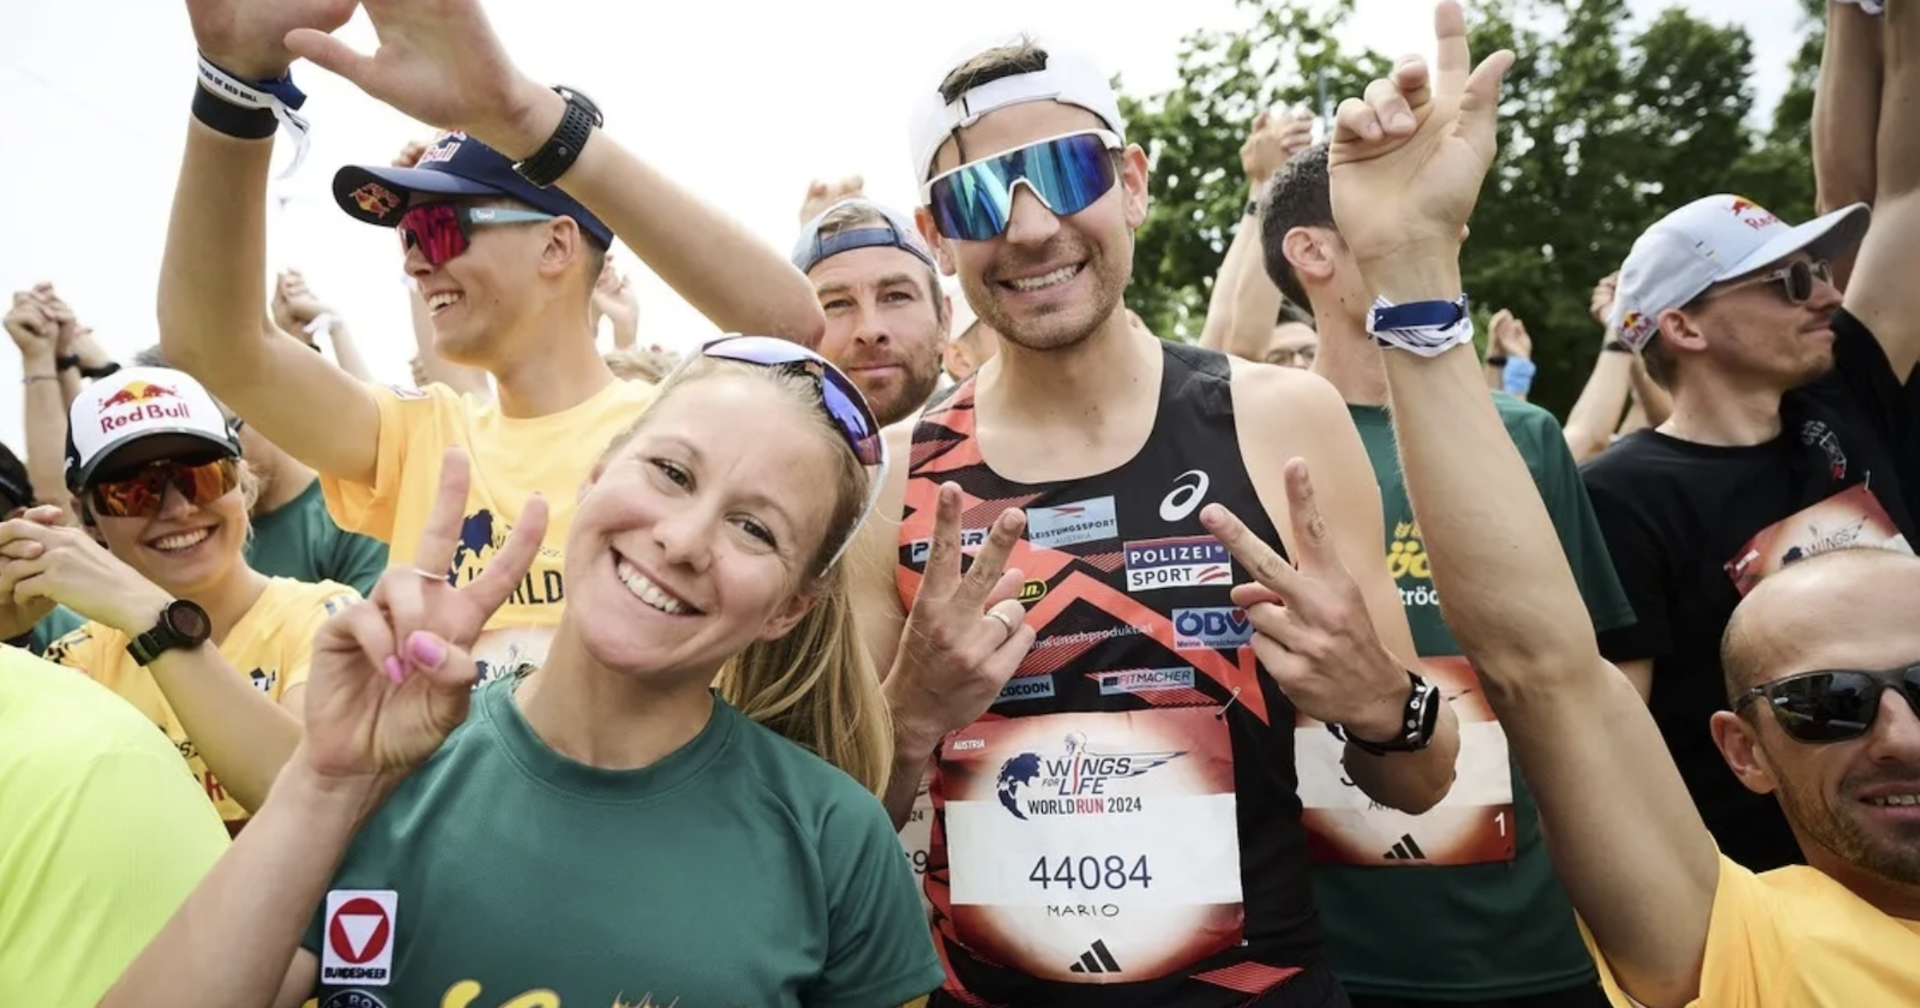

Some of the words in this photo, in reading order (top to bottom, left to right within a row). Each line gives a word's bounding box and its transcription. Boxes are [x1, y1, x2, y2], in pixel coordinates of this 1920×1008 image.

[100, 406, 144, 434] Red
[146, 402, 190, 419] Bull
[1030, 519, 1115, 540] LEISTUNGSSPORT
[1055, 533, 1092, 545] AUSTRIA
[1130, 545, 1211, 564] POLIZEI
[1132, 567, 1192, 587] SPORT
[1119, 670, 1191, 685] FITMACHER
[953, 738, 985, 750] AUSTRIA
[1046, 756, 1131, 776] WINGS
[1042, 778, 1060, 787] FOR
[1058, 777, 1108, 796] LIFE
[1108, 796, 1142, 813] 2024
[1494, 812, 1505, 836] 1
[1029, 854, 1152, 890] 44084
[1047, 903, 1120, 918] MARIO
